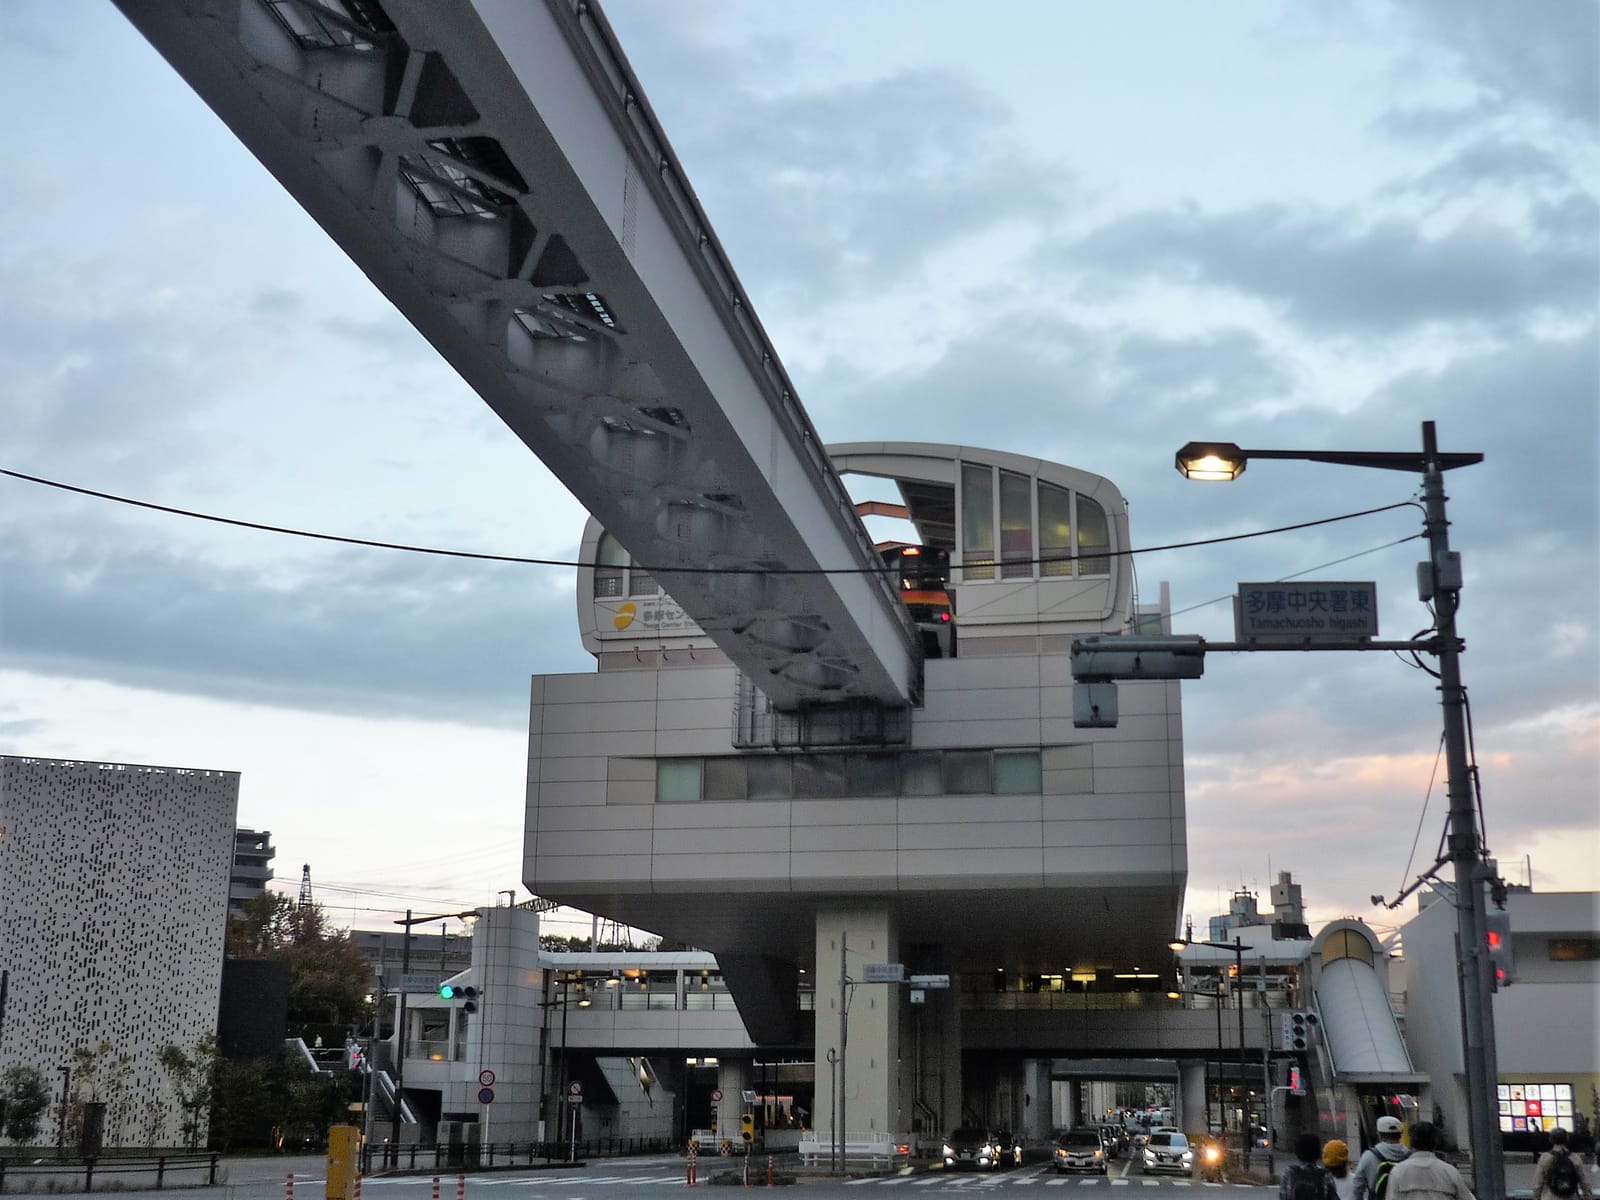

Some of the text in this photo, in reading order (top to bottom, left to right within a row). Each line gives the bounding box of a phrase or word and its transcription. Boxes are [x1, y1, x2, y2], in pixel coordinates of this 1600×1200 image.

[1246, 590, 1370, 614] 多摩中央署東
[1329, 616, 1368, 631] higashi
